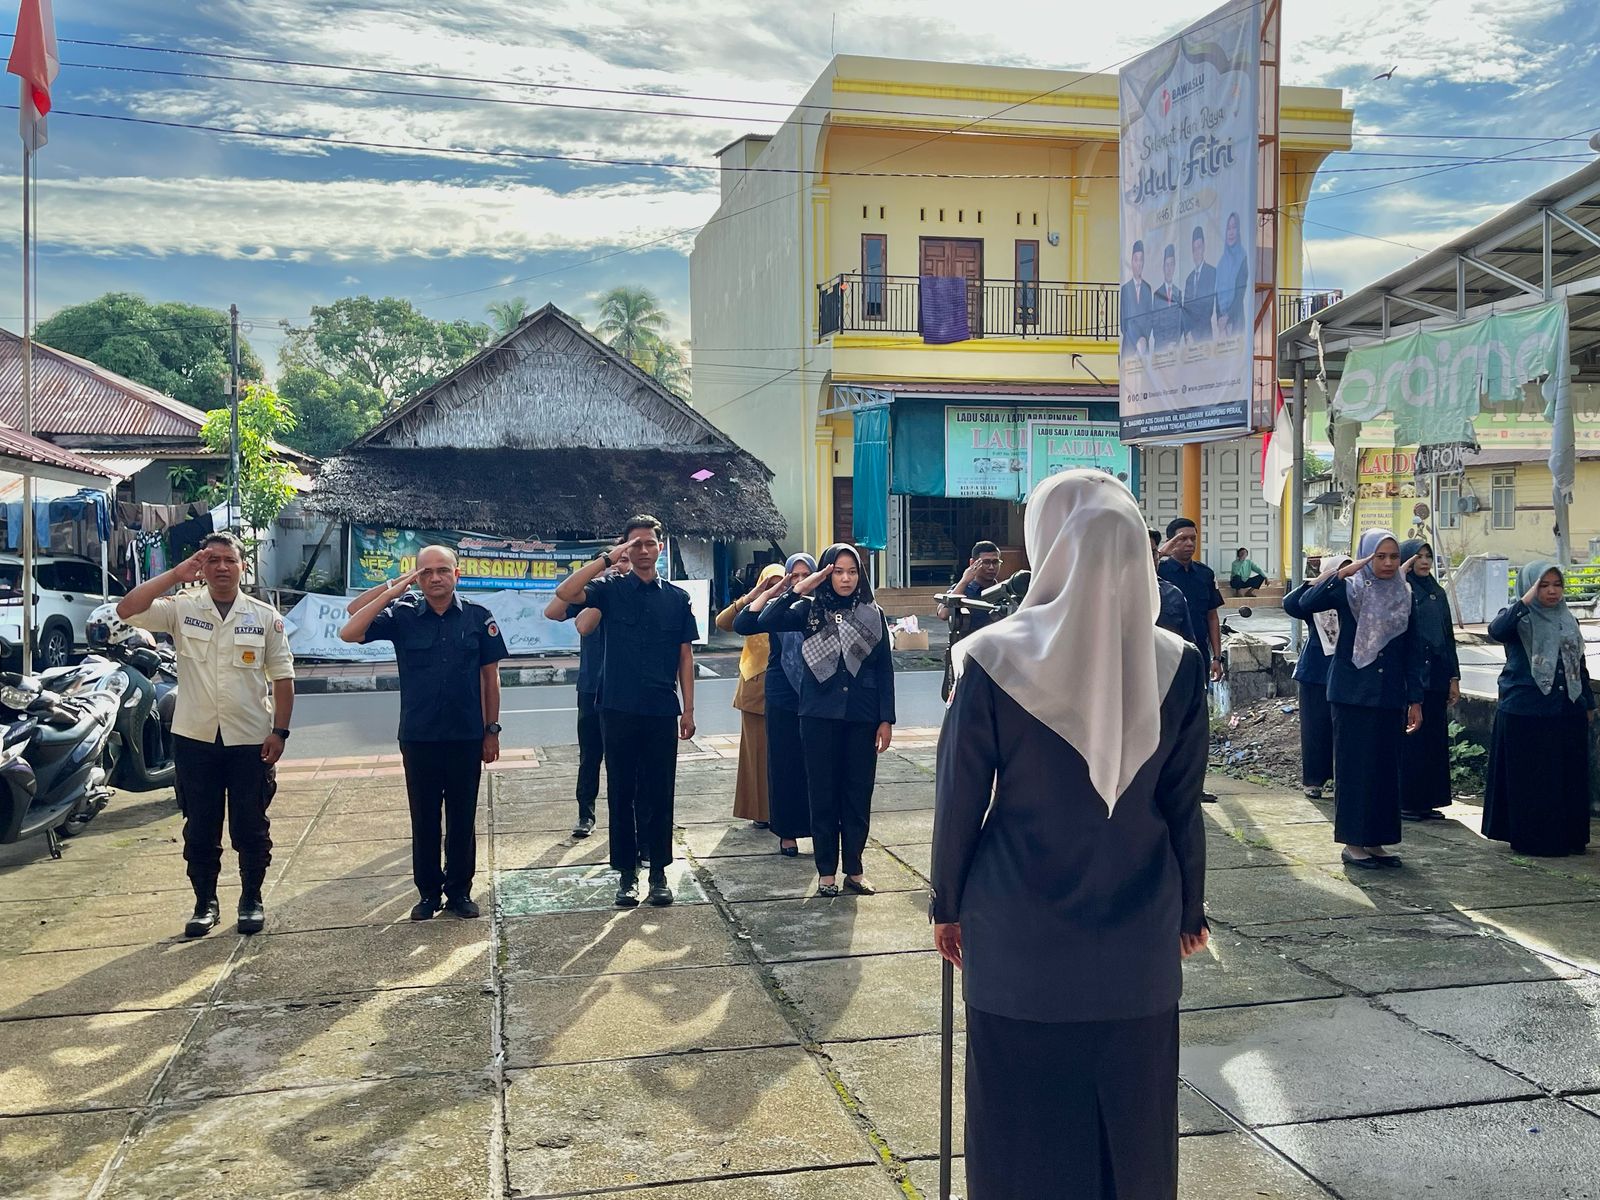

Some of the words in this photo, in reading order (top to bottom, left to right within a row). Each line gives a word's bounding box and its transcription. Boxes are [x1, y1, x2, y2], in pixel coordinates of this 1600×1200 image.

[1171, 73, 1204, 100] BAWASLU
[1141, 126, 1176, 160] Selamat
[956, 412, 978, 423] LADU
[980, 412, 1001, 423] SALA
[1038, 428, 1053, 436] LADU
[1054, 428, 1068, 436] SALA
[1074, 429, 1089, 437] LADU
[1090, 429, 1104, 437] ARAI
[1360, 452, 1417, 475] LAUDI
[531, 560, 568, 579] KE-
